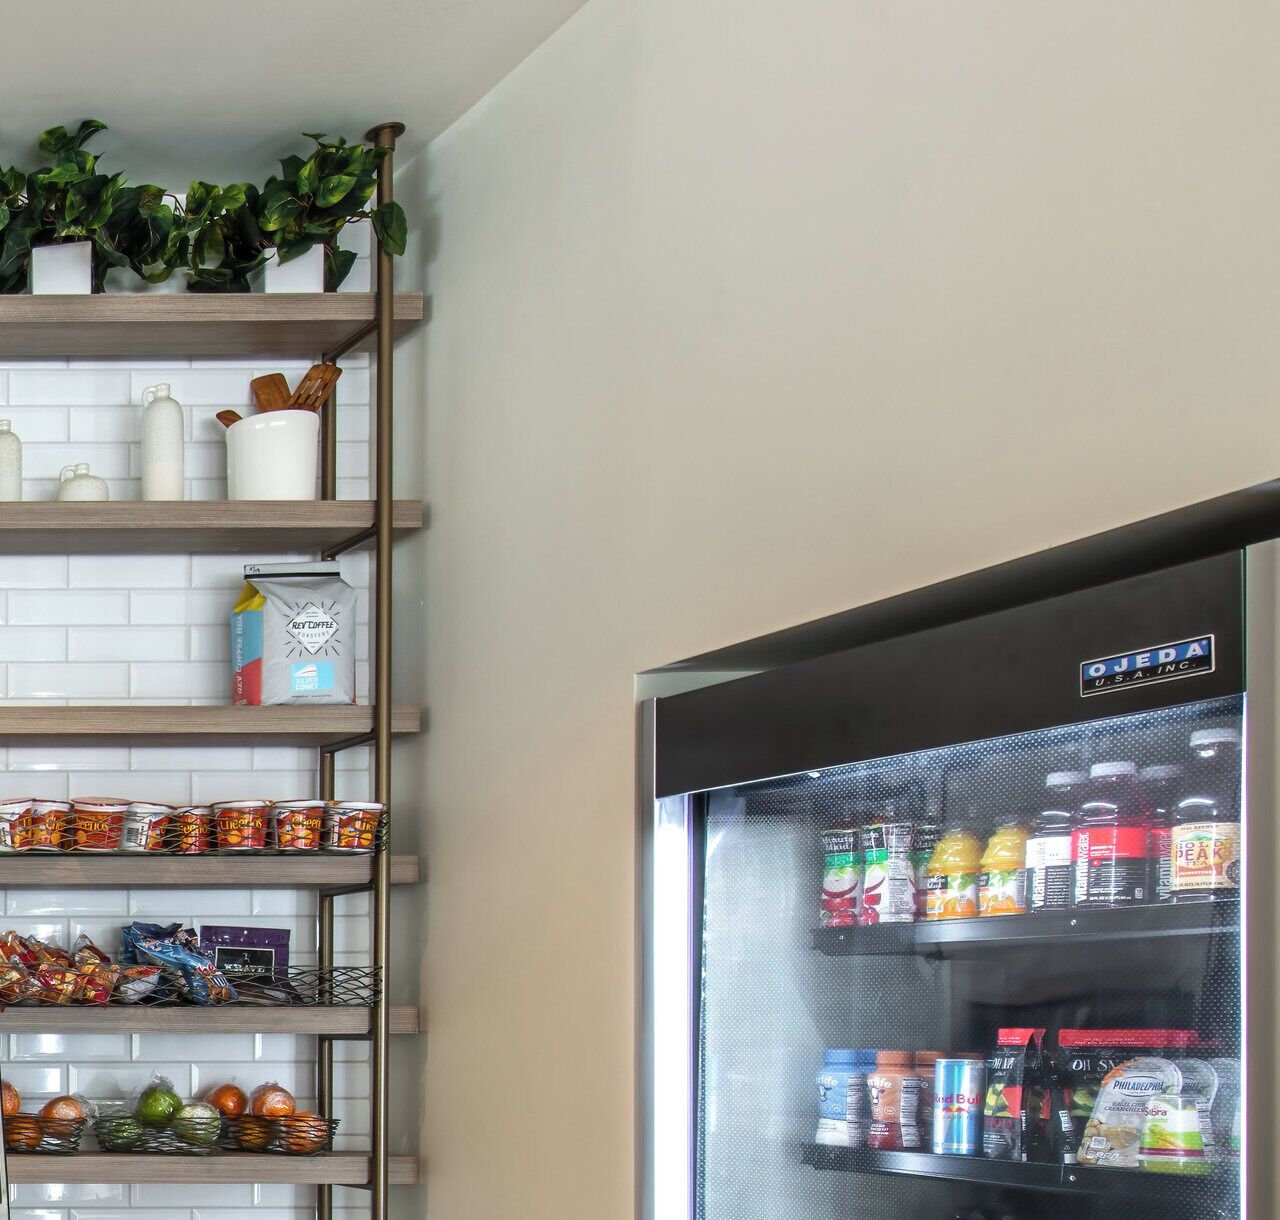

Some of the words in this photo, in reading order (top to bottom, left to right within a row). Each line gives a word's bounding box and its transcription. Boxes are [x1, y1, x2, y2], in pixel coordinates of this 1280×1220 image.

[306, 620, 334, 629] COFFEE
[1089, 642, 1203, 677] OJEDA
[1096, 671, 1150, 686] U.S.A.
[1158, 661, 1196, 674] INC.
[1175, 840, 1225, 850] GOLD
[1175, 848, 1226, 862] PEAK
[1075, 832, 1090, 904] vitaminwater
[1113, 1080, 1165, 1091] PHILADELPHIA
[934, 1094, 954, 1104] Red
[956, 1094, 982, 1105] Bull
